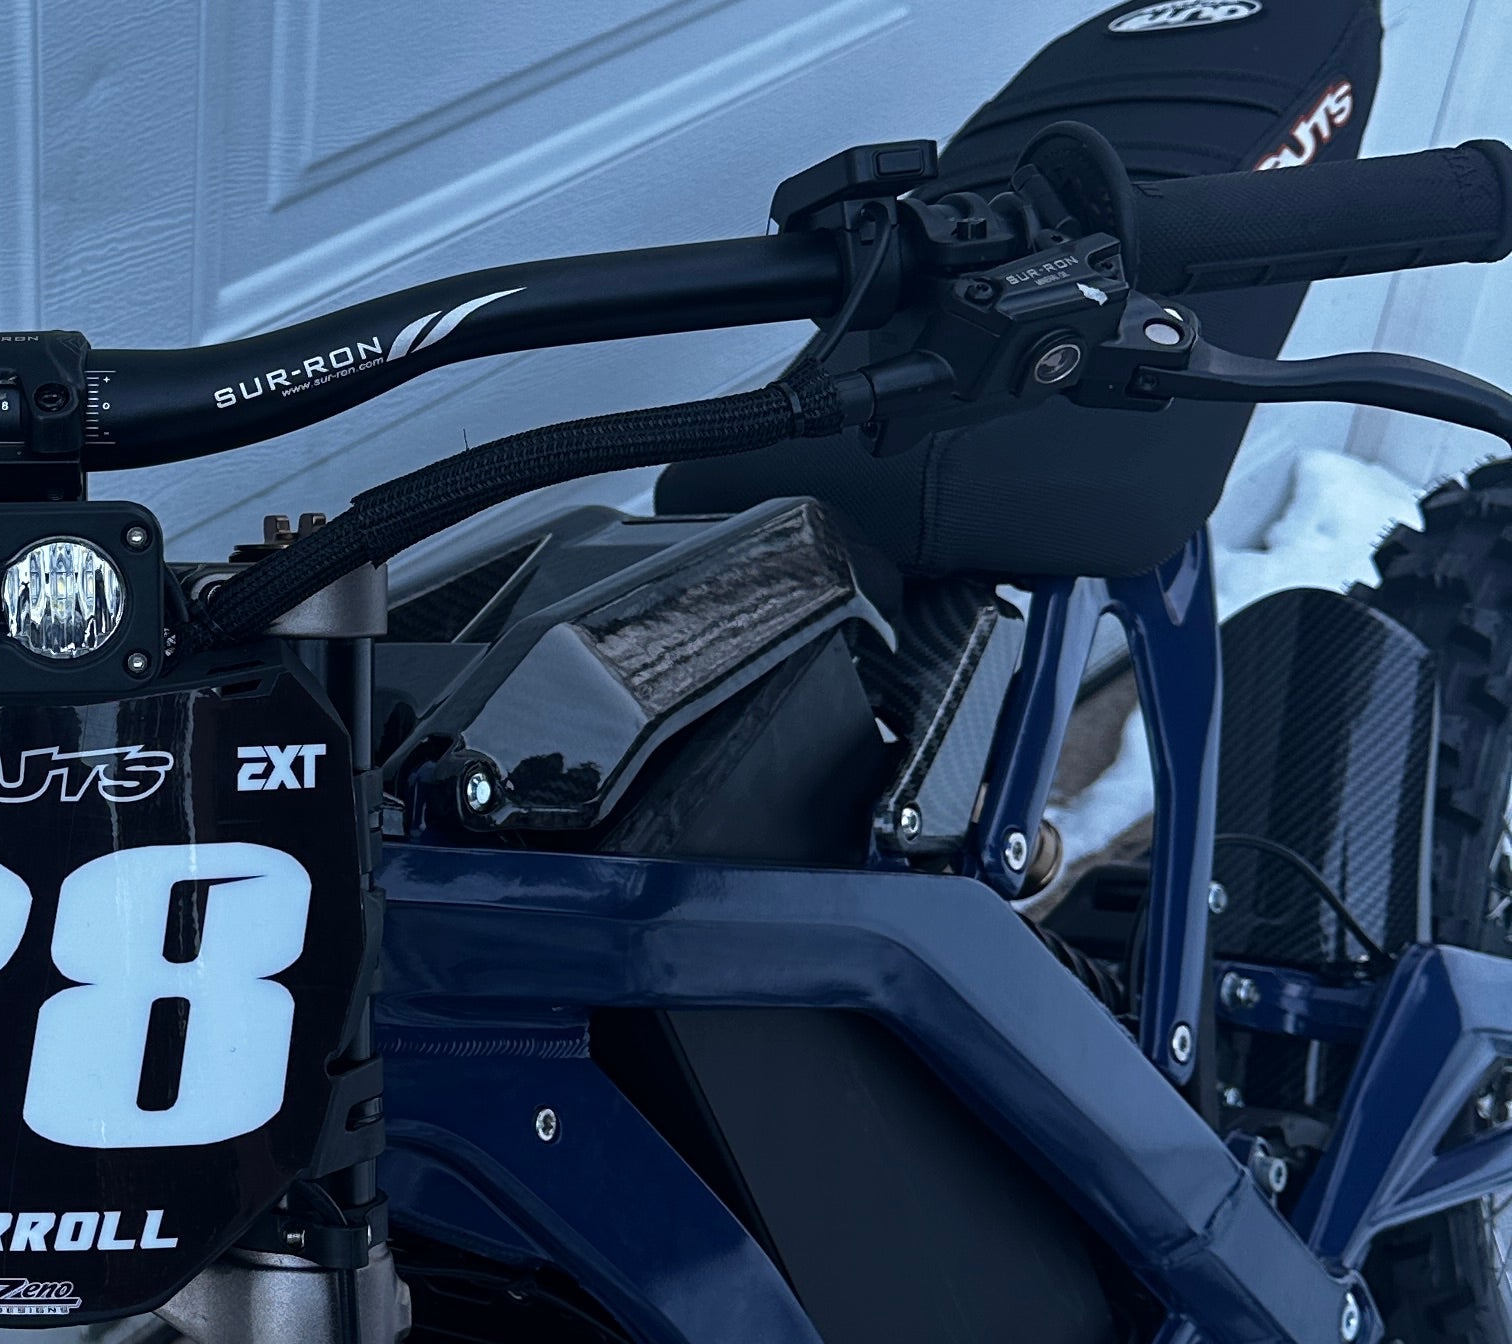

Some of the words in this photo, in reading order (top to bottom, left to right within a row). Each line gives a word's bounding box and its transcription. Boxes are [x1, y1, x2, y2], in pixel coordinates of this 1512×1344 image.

[1005, 255, 1079, 285] SUR-RON
[214, 336, 383, 409] SUR-RON
[281, 356, 384, 398] www.sur-ron.com
